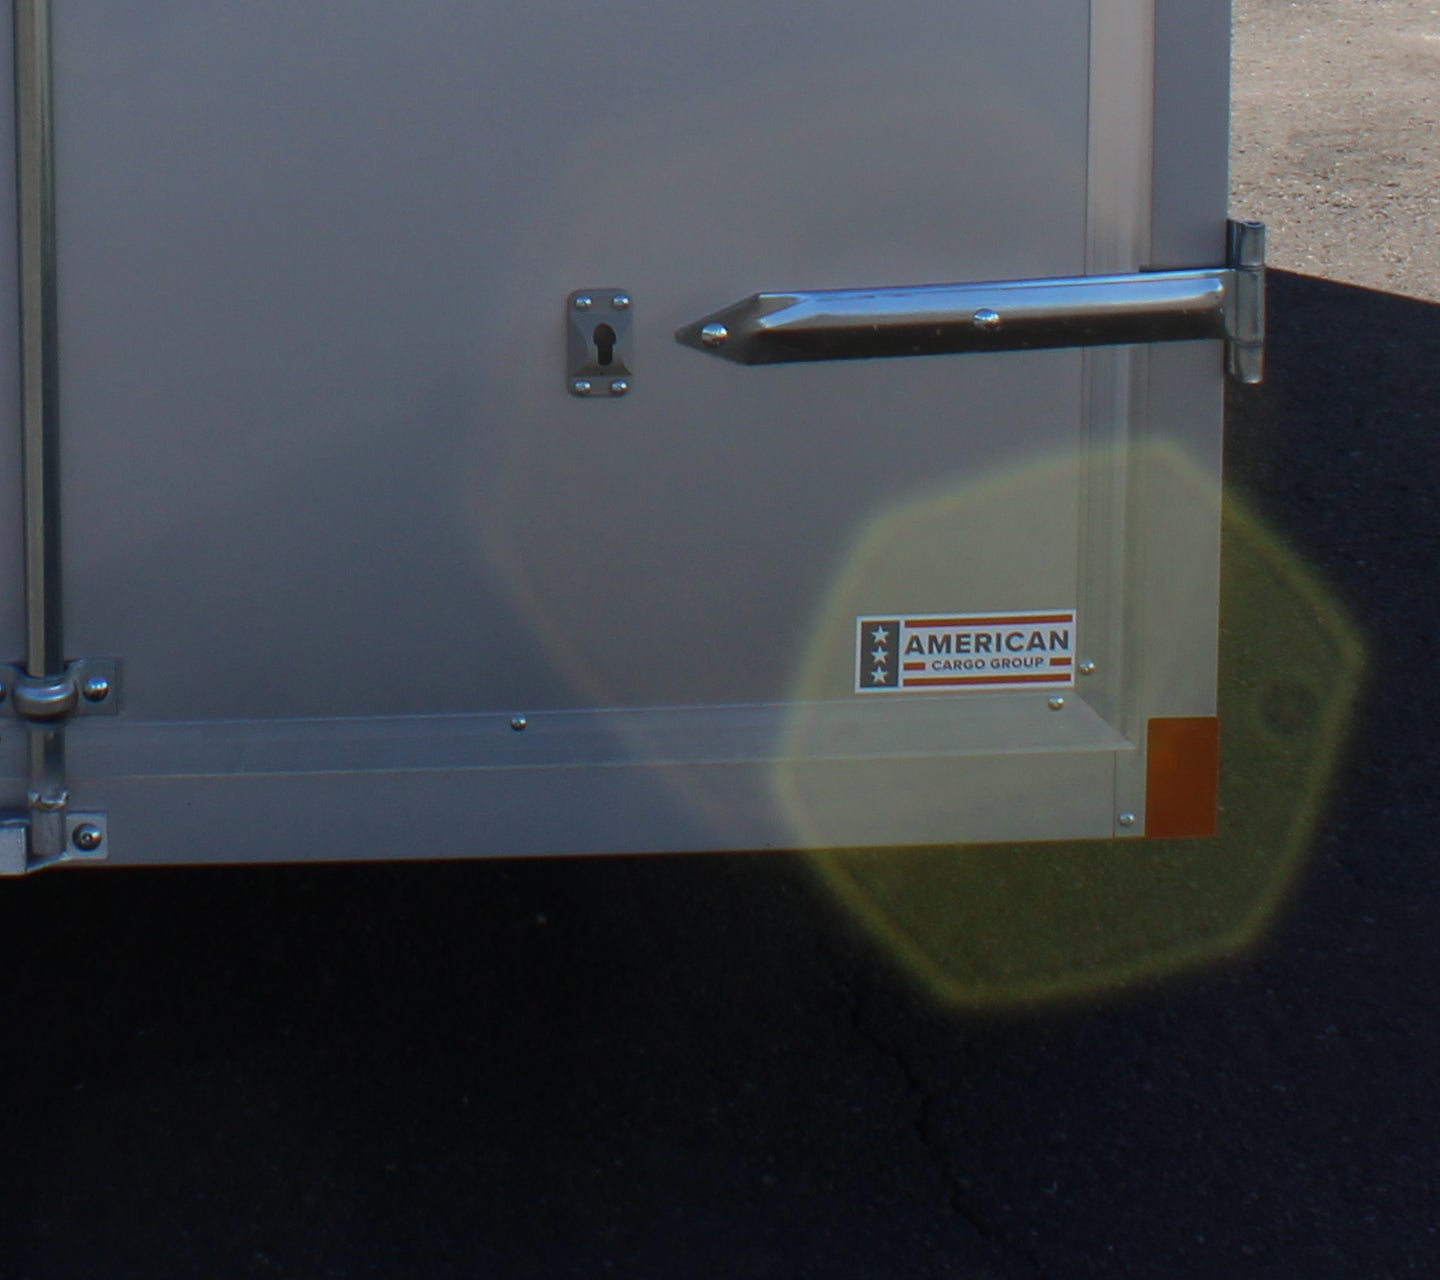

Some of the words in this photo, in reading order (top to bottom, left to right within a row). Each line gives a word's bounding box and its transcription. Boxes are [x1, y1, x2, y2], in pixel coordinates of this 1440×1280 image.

[904, 630, 1069, 656] AMERICAN
[931, 659, 986, 672] CARGO
[990, 657, 1044, 670] GROUP
